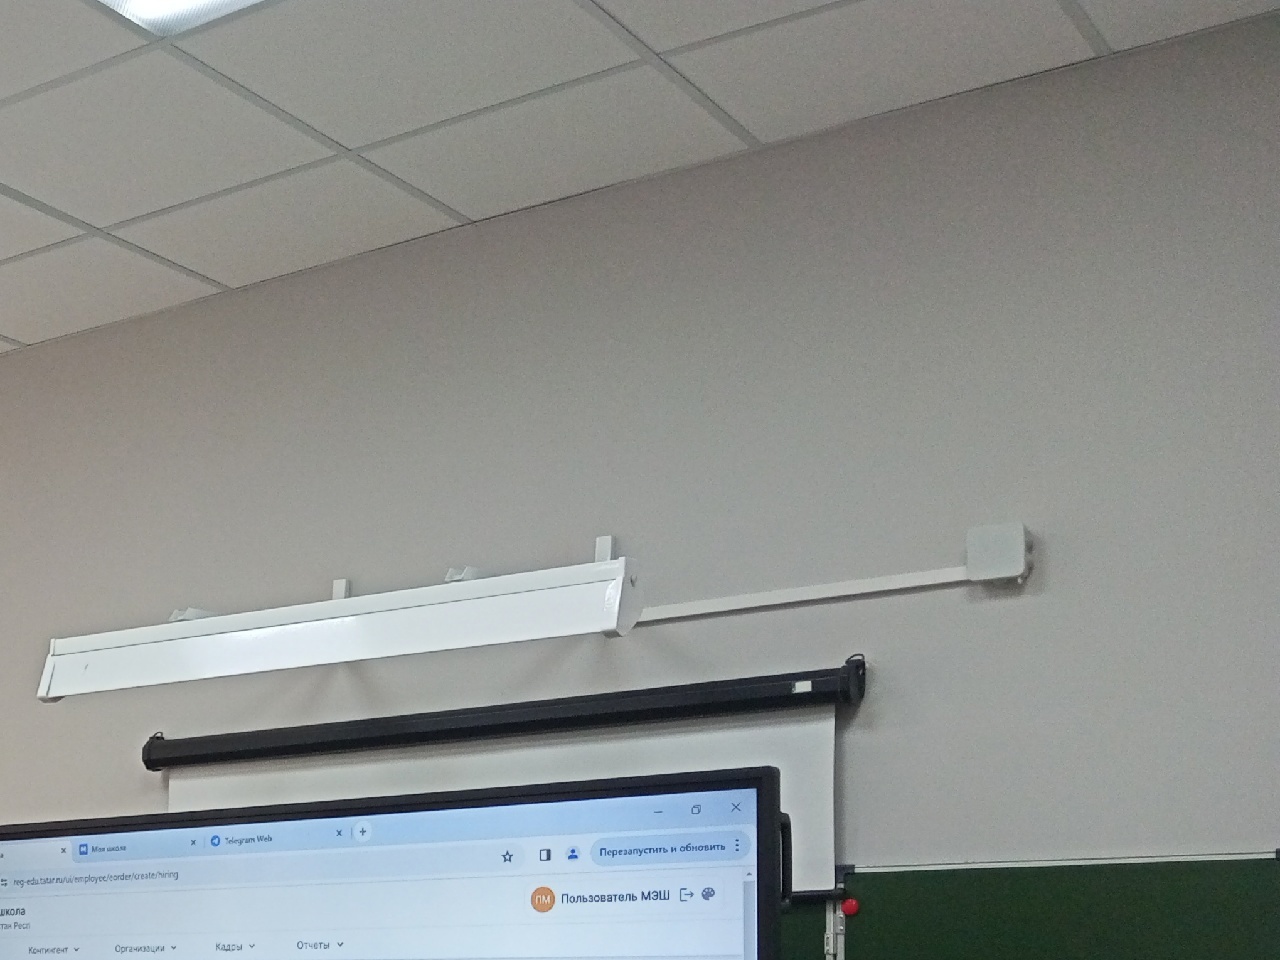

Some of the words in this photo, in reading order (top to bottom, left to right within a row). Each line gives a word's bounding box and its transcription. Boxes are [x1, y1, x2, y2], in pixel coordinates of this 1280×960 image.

[225, 836, 255, 846] Telegram
[257, 834, 273, 843] Web
[599, 844, 668, 857] Перезапустить
[679, 842, 726, 853] обновить
[535, 895, 551, 905] ПМ
[561, 892, 638, 904] Пользователь
[641, 889, 670, 902] МЭШ
[28, 946, 68, 955] Контингент
[114, 944, 165, 955] Организации
[215, 942, 243, 952] Кадры
